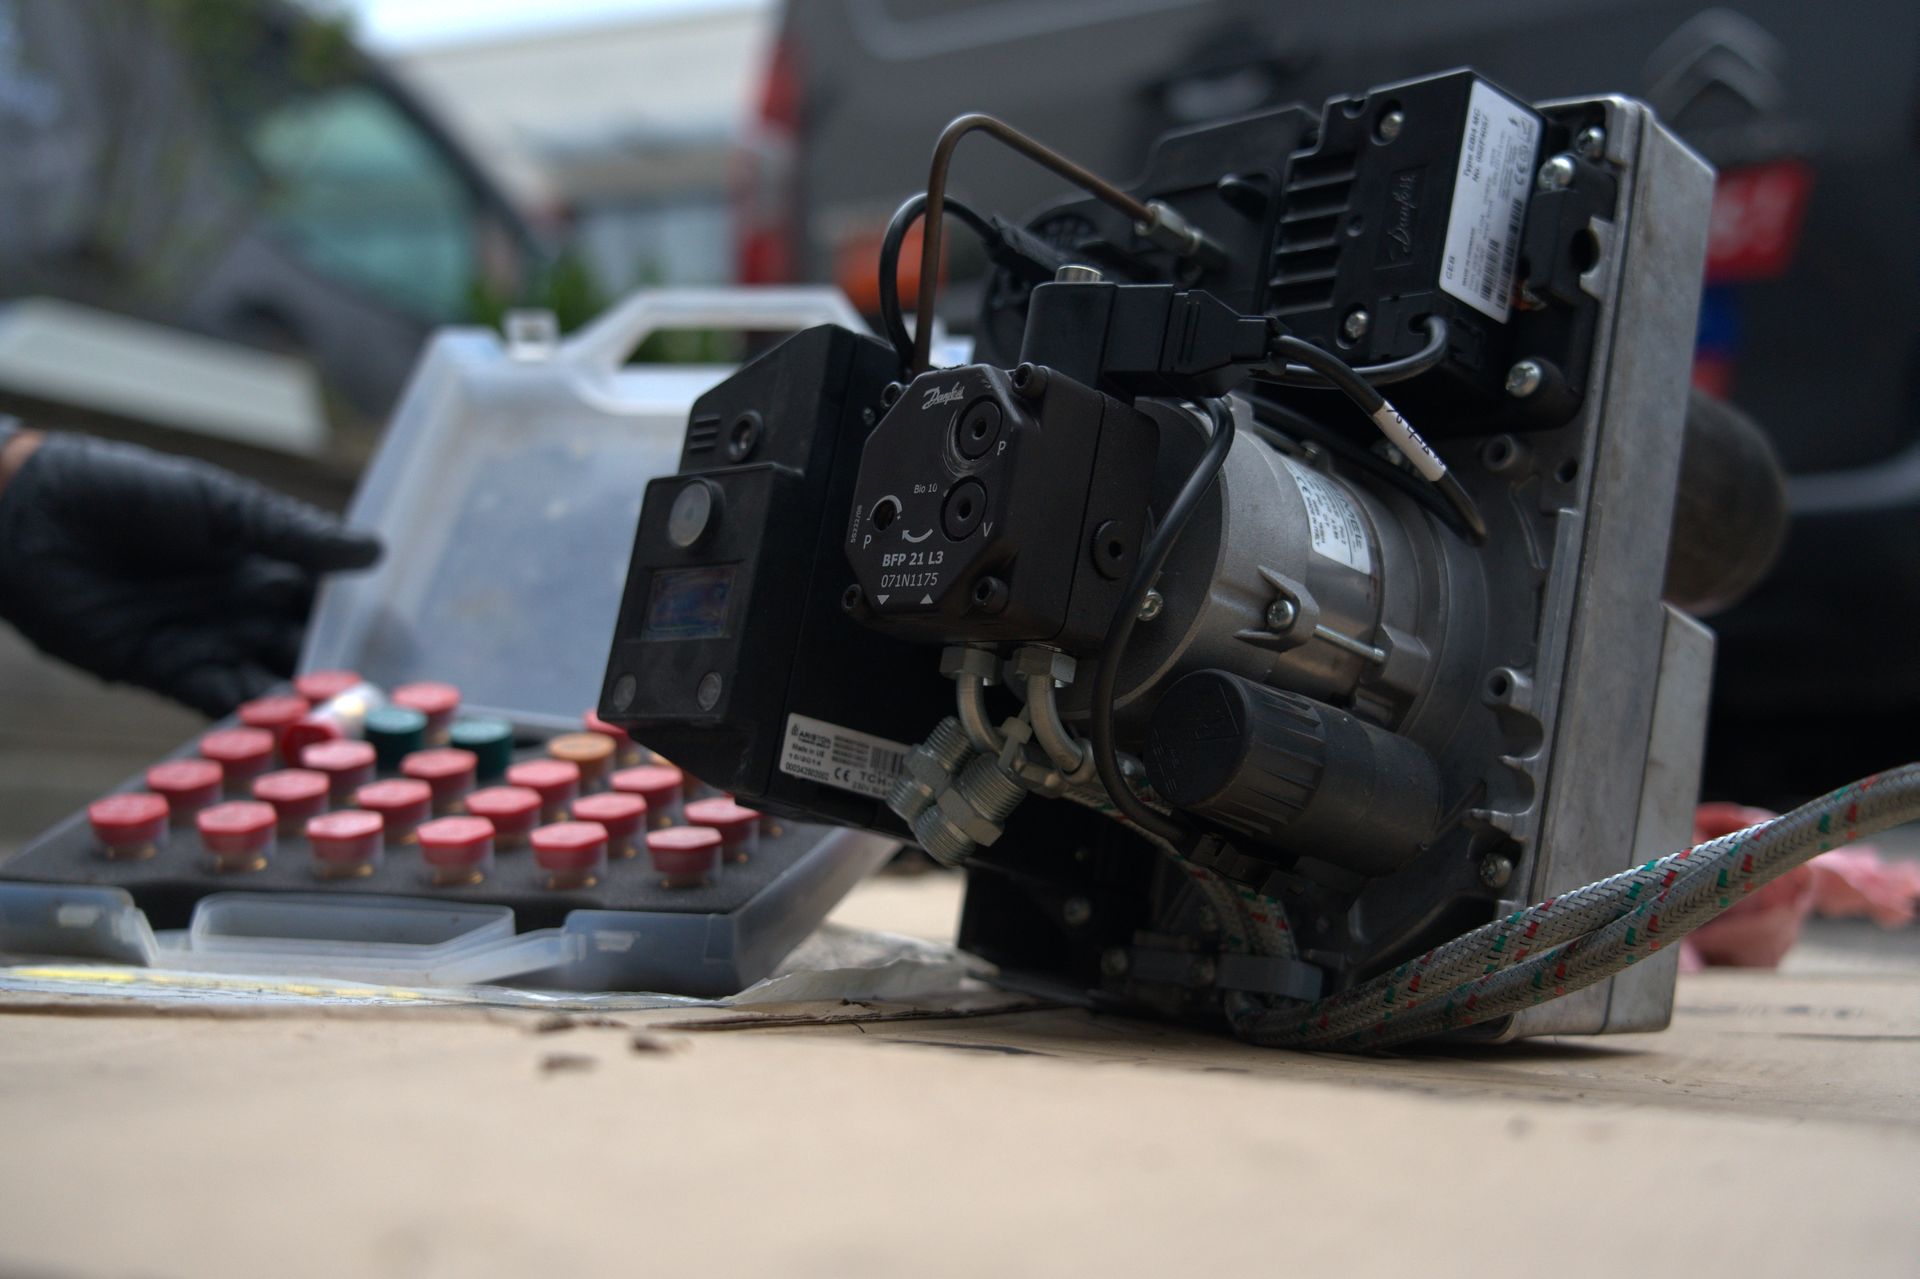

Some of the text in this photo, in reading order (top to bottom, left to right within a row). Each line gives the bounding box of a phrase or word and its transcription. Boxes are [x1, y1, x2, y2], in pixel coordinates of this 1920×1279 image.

[996, 440, 1006, 456] P
[914, 483, 938, 494] Bio 10
[983, 522, 994, 537] V
[863, 534, 872, 550] P
[882, 551, 943, 567] BFP 21 L3
[881, 573, 938, 588] 071N1175
